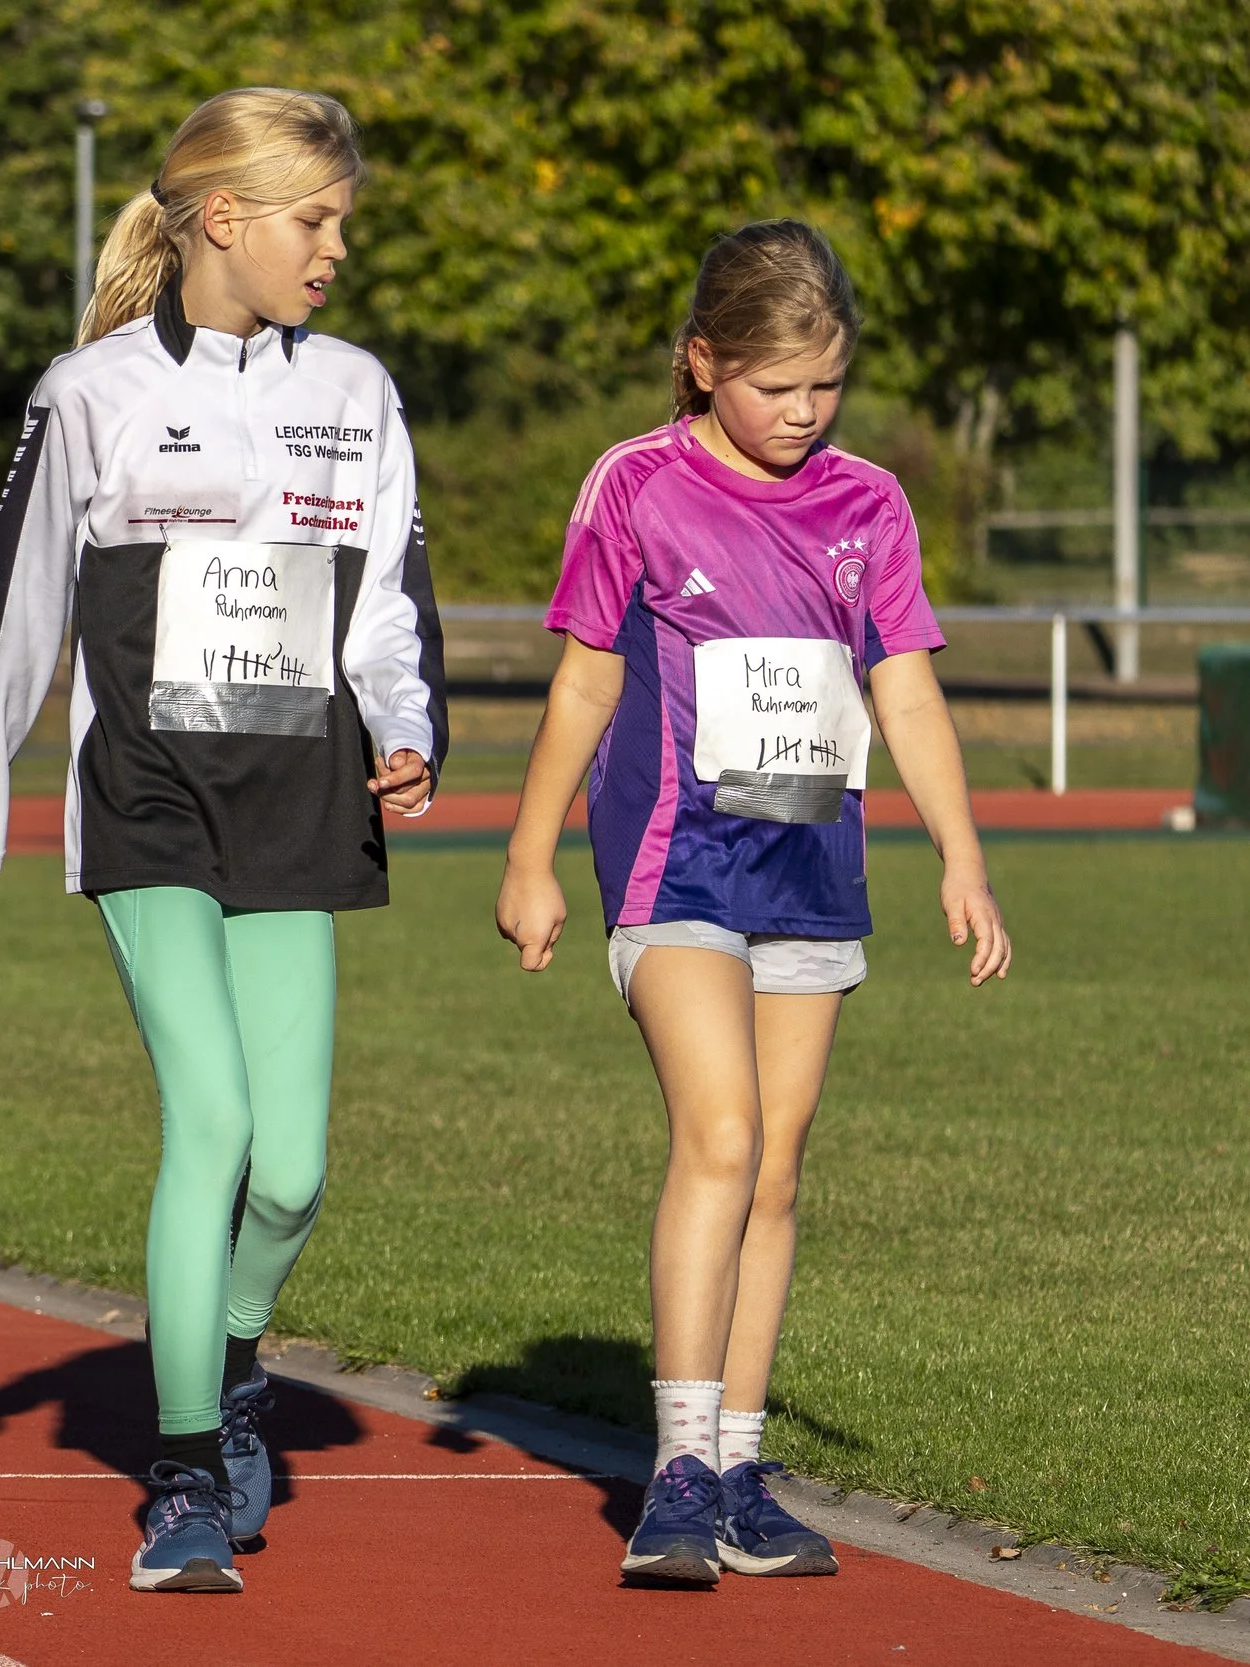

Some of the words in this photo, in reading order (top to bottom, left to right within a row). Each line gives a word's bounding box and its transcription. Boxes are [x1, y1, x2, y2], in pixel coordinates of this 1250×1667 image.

[275, 426, 373, 442] LEICHTATHLETIK
[159, 442, 201, 453] erima
[286, 444, 311, 458] TSG
[283, 492, 364, 512] Freizeitpark
[291, 512, 358, 531] Lochmühle
[203, 556, 278, 591] Anna
[215, 594, 287, 623] Ruhrmann
[745, 653, 802, 689] Mira
[752, 693, 818, 715] Ruhrmann
